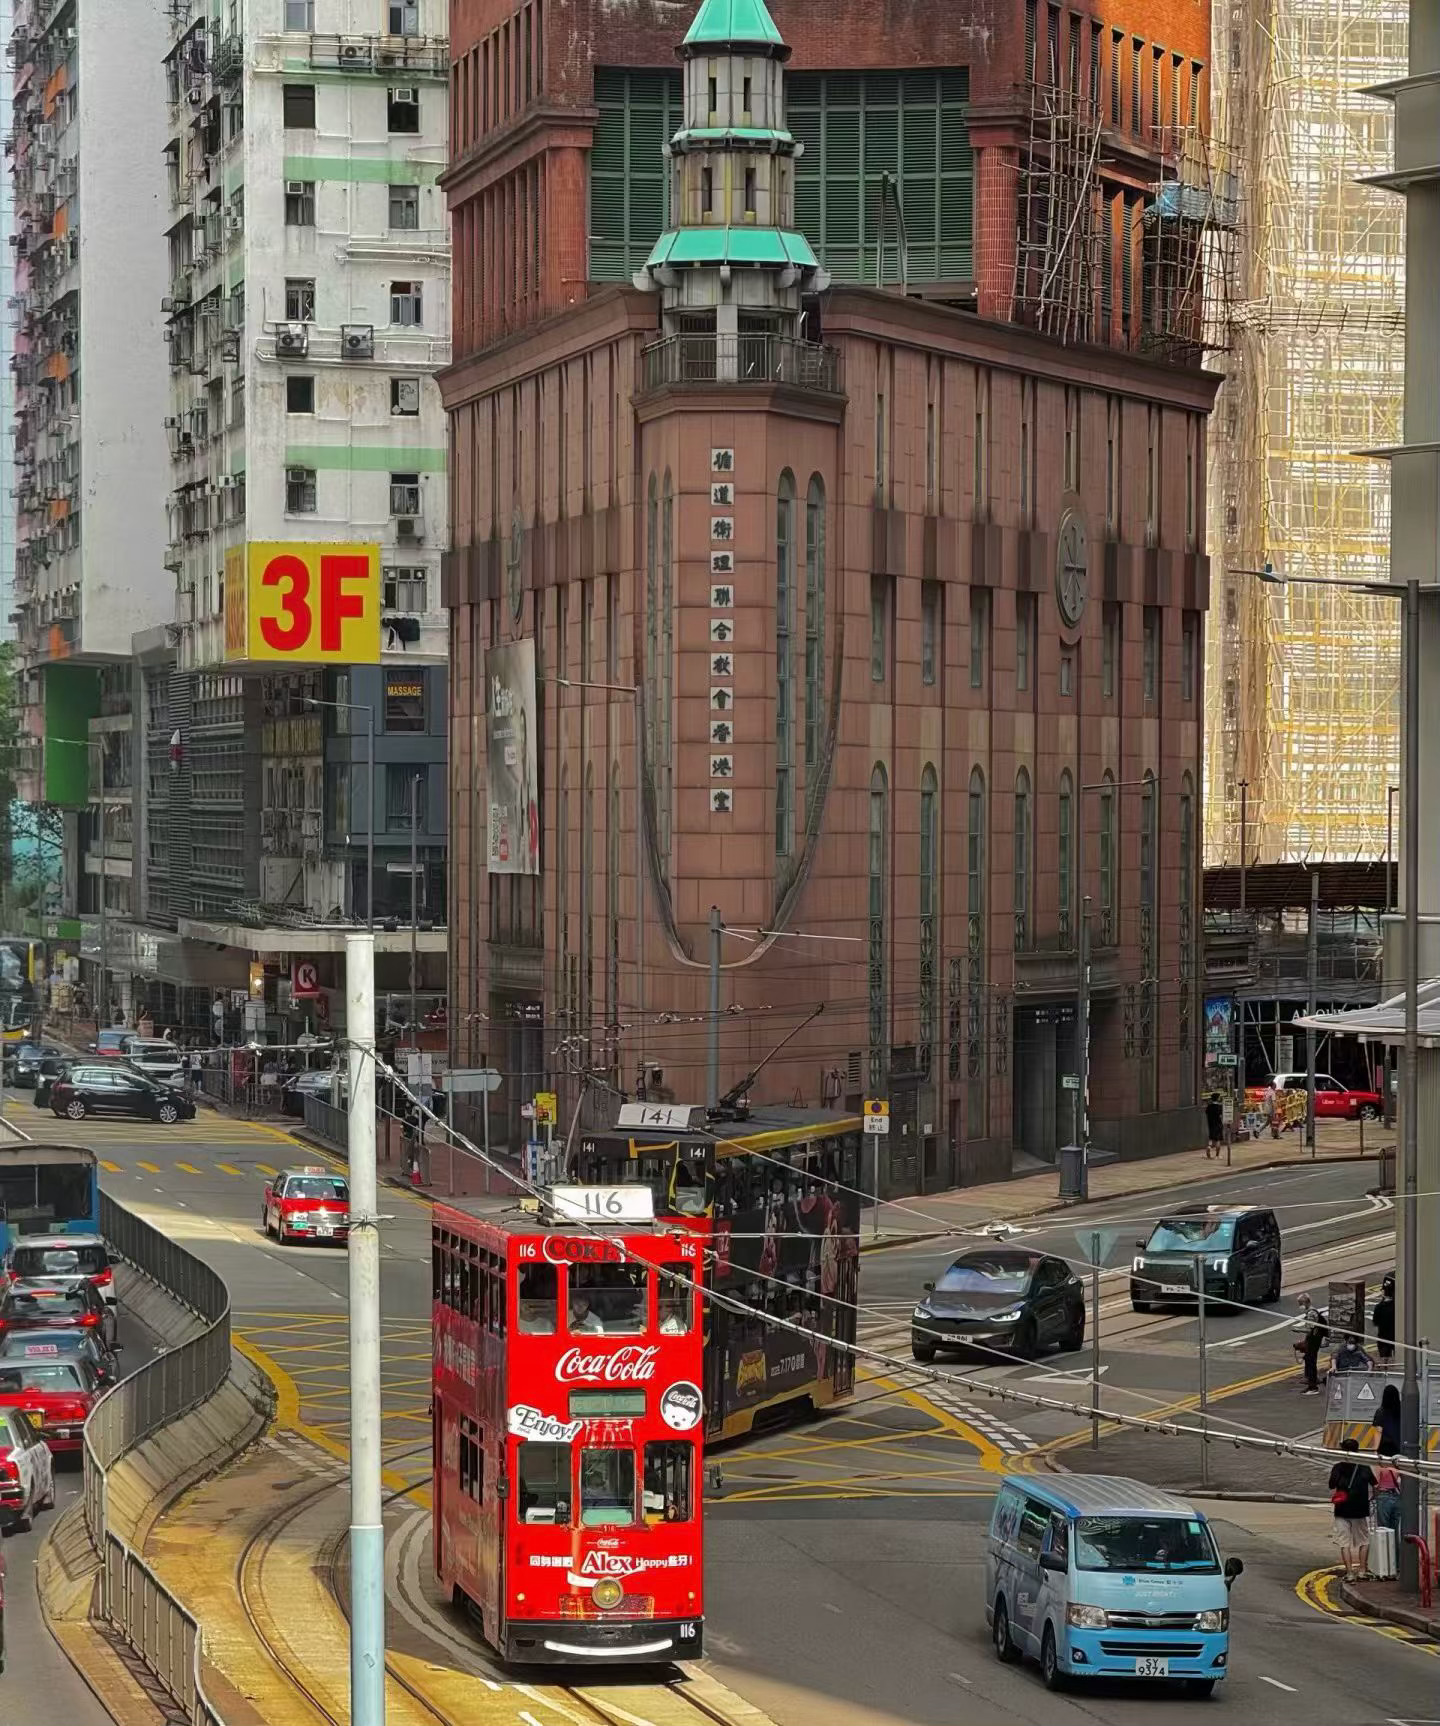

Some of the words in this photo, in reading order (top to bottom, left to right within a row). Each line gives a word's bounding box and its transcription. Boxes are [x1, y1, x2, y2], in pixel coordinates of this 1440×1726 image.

[259, 554, 370, 651] 3F
[387, 686, 422, 696] MASSAGE
[302, 968, 313, 983] K
[640, 1108, 672, 1124] 141
[582, 1142, 595, 1153] 141
[690, 1147, 706, 1158] 141
[584, 1192, 623, 1215] 116
[519, 1244, 536, 1257] 116
[681, 1243, 697, 1257] 116
[515, 1406, 581, 1440] Enjoy!
[582, 1551, 632, 1573] Alex
[680, 1623, 696, 1638] 116
[1145, 1658, 1159, 1667] SY
[1138, 1666, 1166, 1677] 9374
